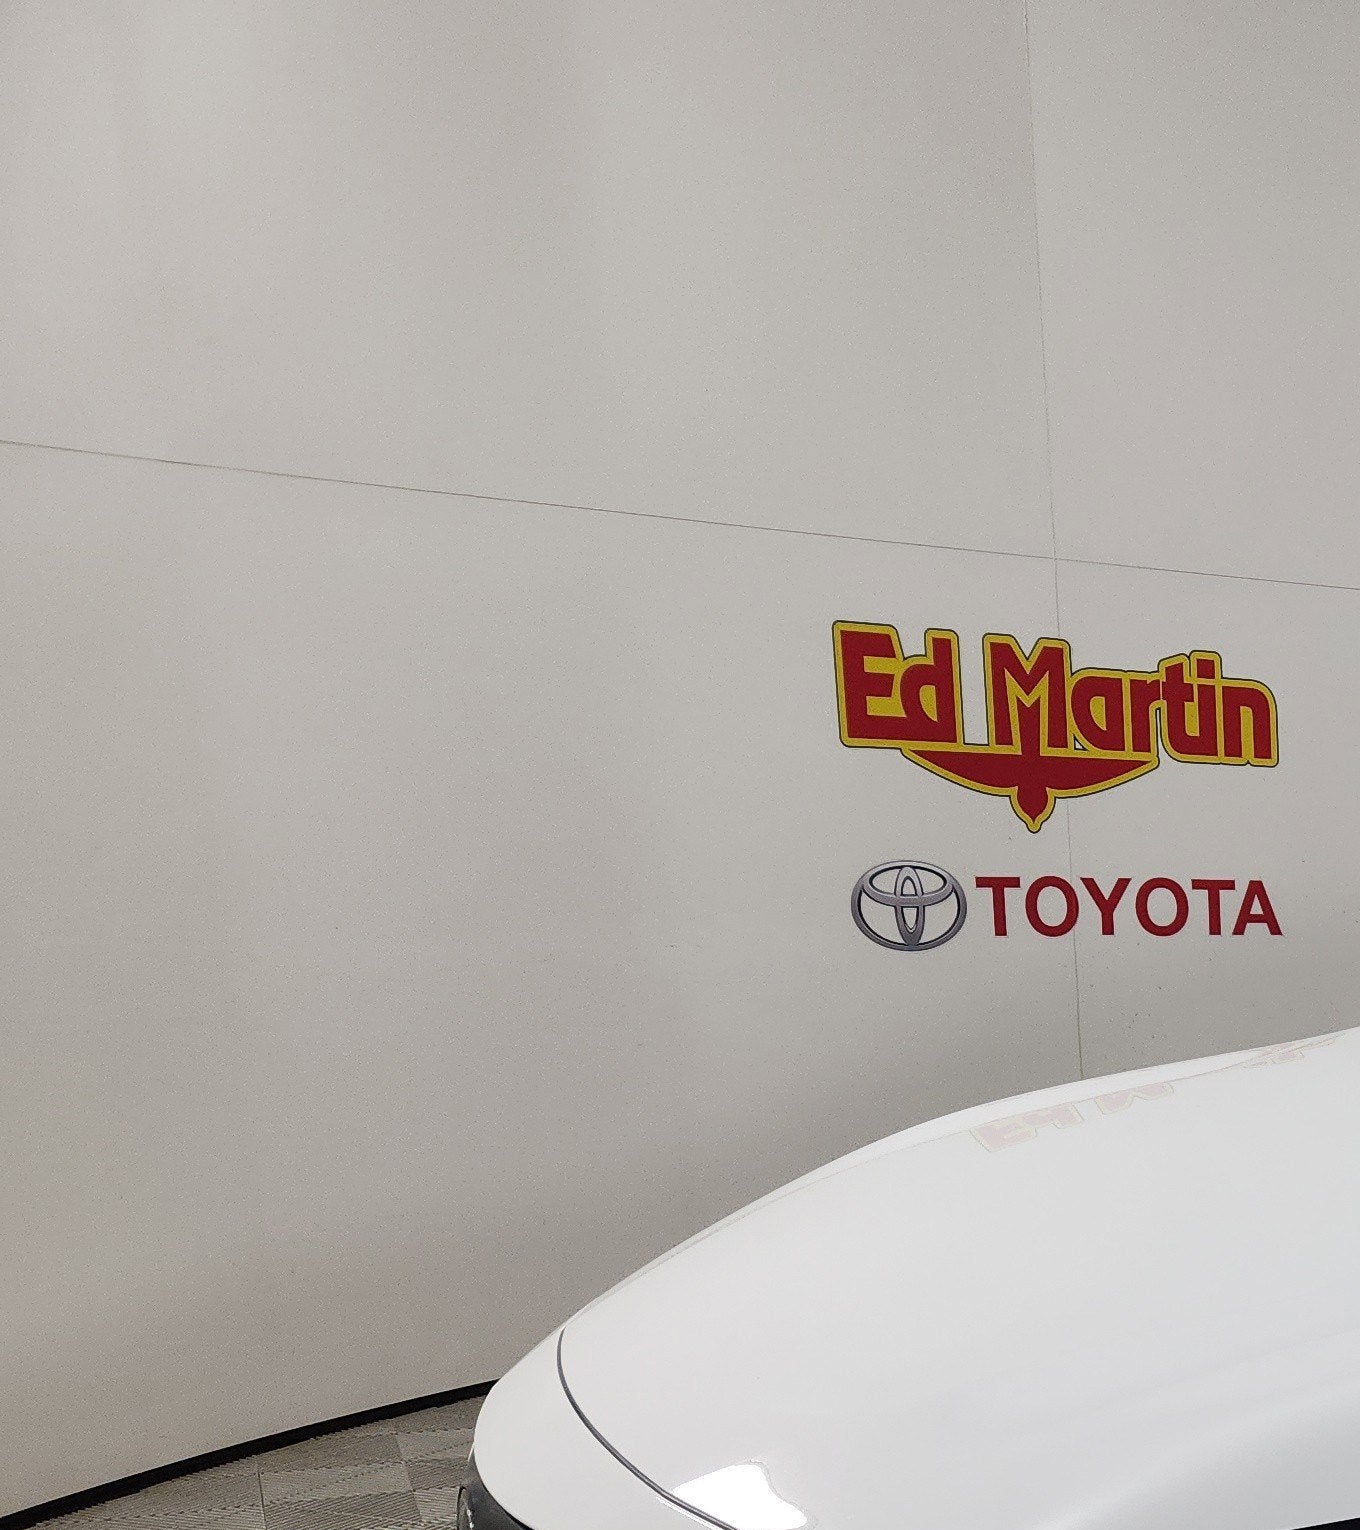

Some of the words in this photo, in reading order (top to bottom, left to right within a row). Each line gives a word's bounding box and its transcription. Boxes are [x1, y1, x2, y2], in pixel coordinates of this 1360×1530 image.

[832, 620, 962, 748] Ed
[983, 633, 1279, 767] Martin
[975, 875, 1283, 937] TOYOTA
